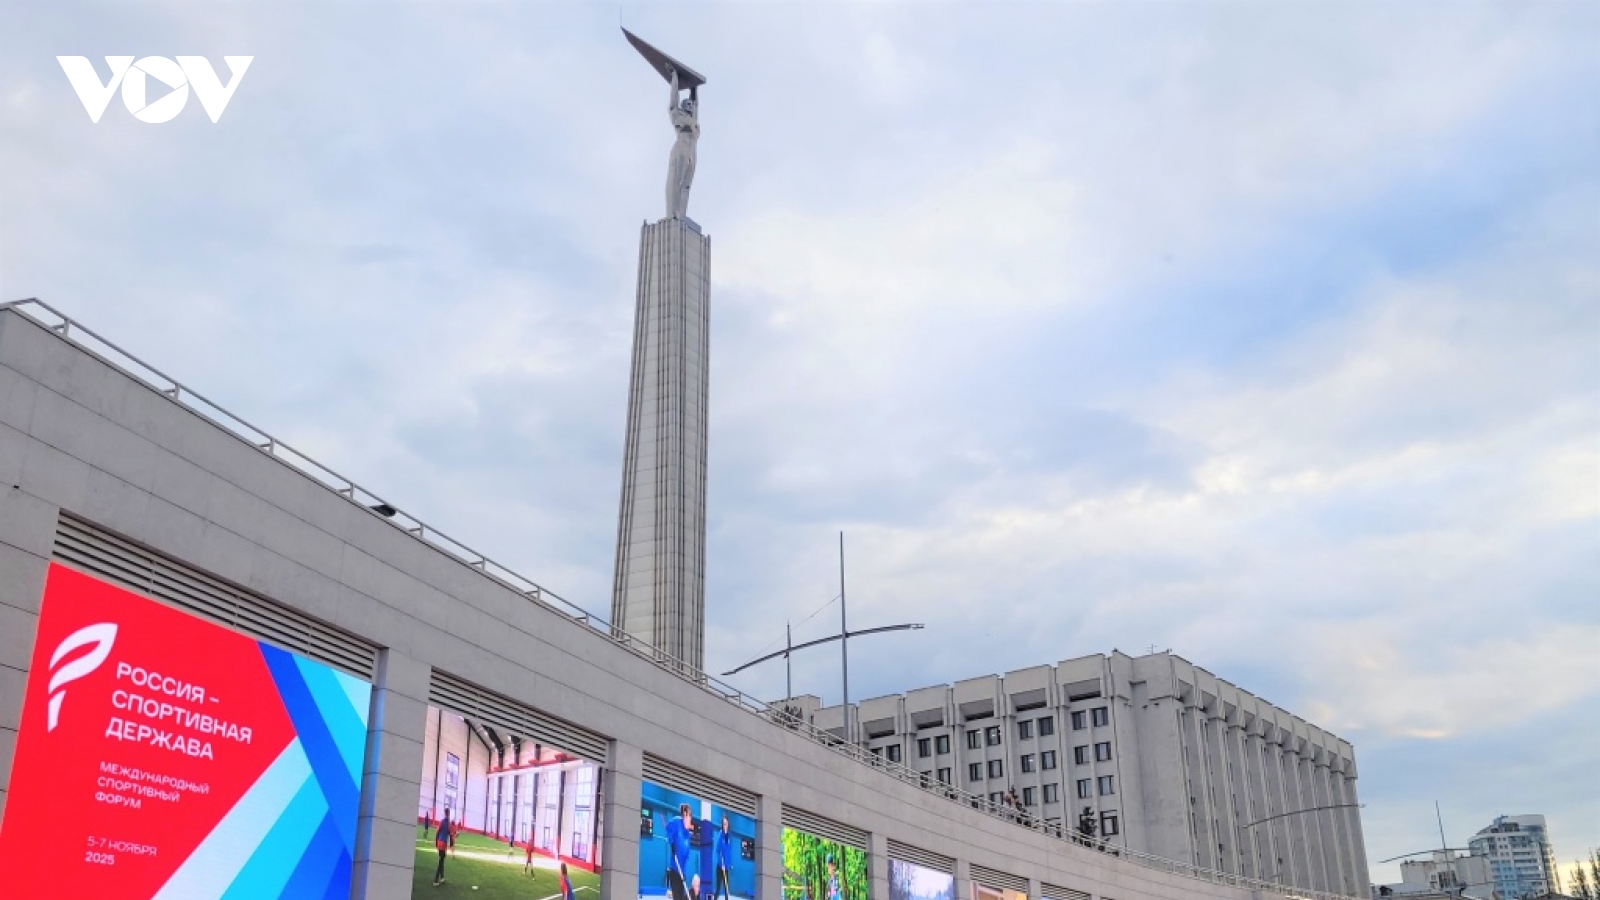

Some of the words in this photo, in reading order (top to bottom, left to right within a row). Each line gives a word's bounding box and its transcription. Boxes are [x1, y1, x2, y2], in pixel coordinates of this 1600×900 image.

[116, 661, 205, 704] РОССИЯ
[111, 690, 252, 744] СПОРТИВНАЯ
[105, 717, 214, 760] ДЕРЖАВА
[97, 777, 180, 803] СПОРТИВНЫЙ
[99, 761, 210, 795] МЕЖДУНАРОДНЫЙ
[95, 791, 142, 809] ФОРУМ
[85, 852, 115, 866] 2025
[87, 836, 106, 848] 5-7
[108, 840, 157, 857] НОЯБРЯ
